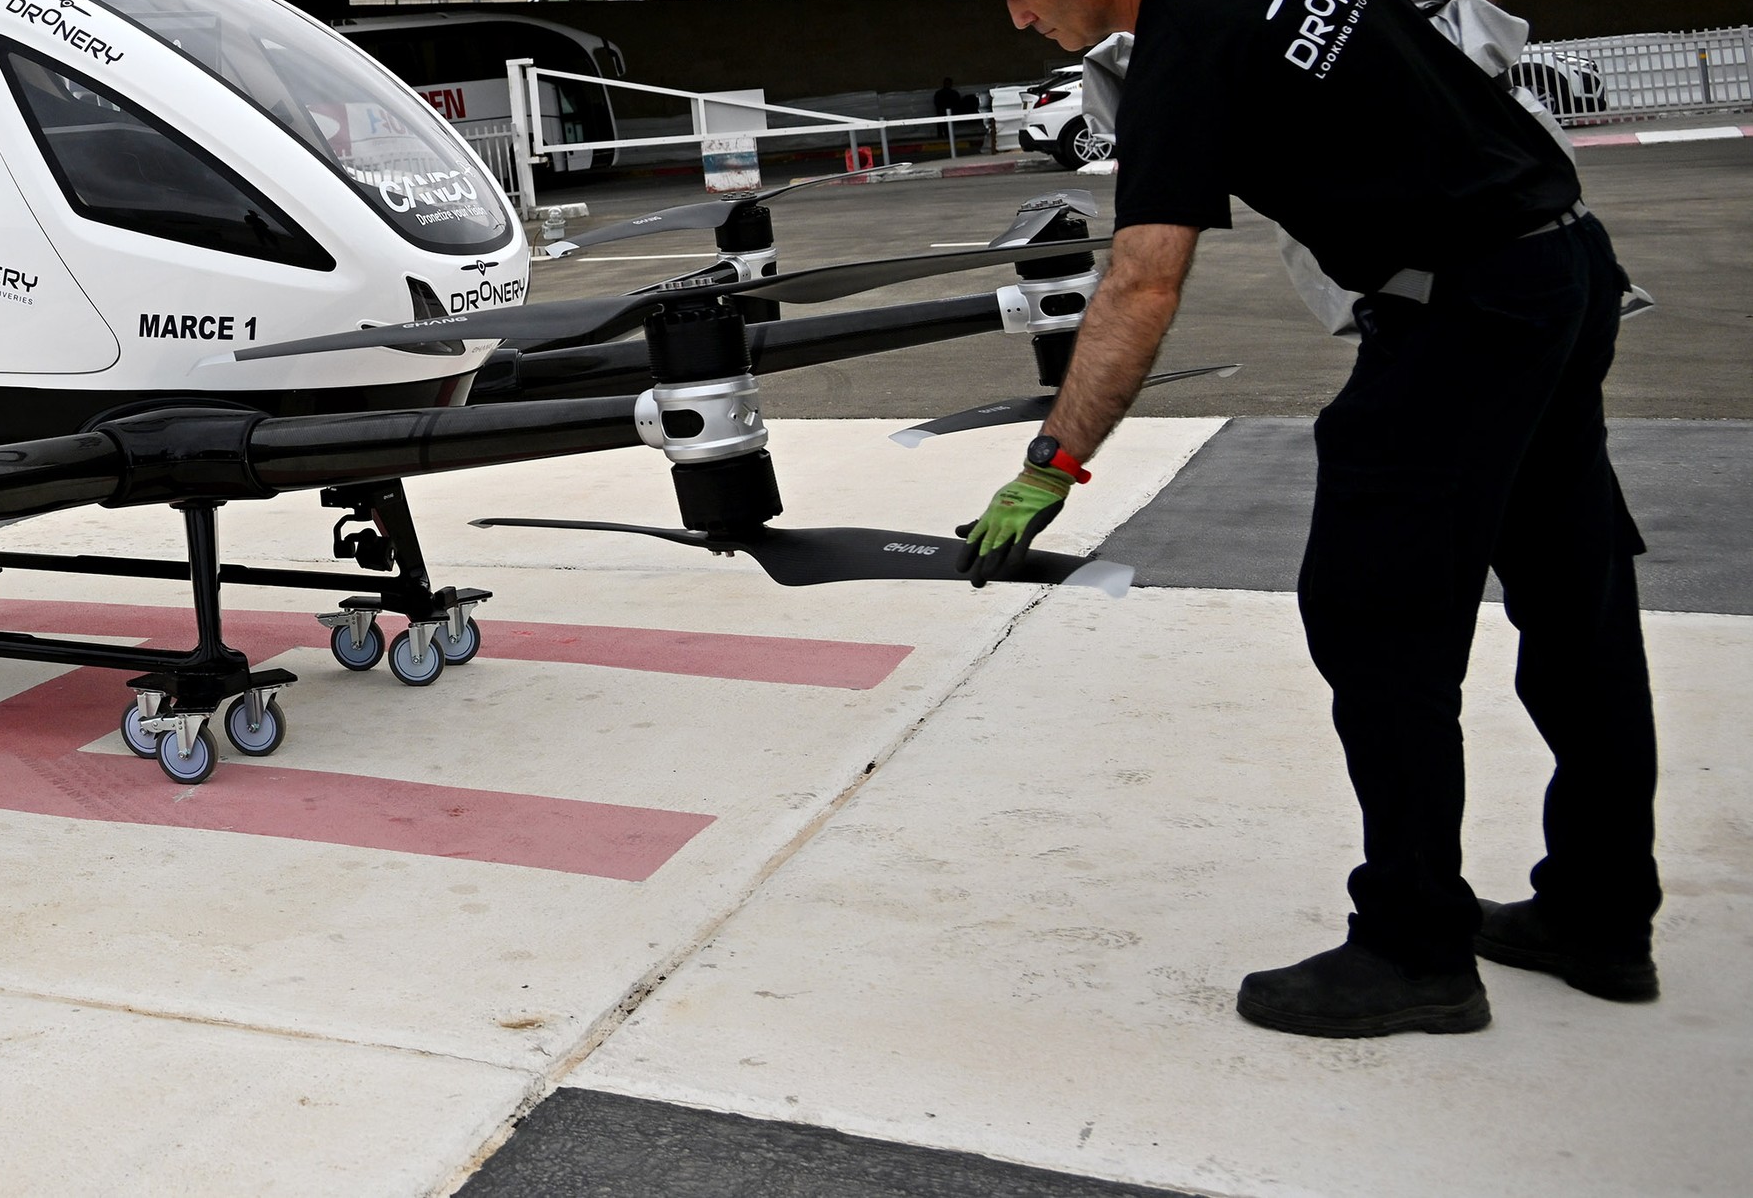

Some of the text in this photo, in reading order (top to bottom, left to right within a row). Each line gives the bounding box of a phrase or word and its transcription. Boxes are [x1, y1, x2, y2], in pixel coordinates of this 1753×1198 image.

[1315, 25, 1353, 79] LOOKING
[1347, 9, 1361, 24] UP
[379, 170, 477, 213] CANDO
[415, 205, 488, 226] Dronetize your Vision
[450, 277, 525, 314] DRONERY
[139, 314, 257, 340] MARCE 1
